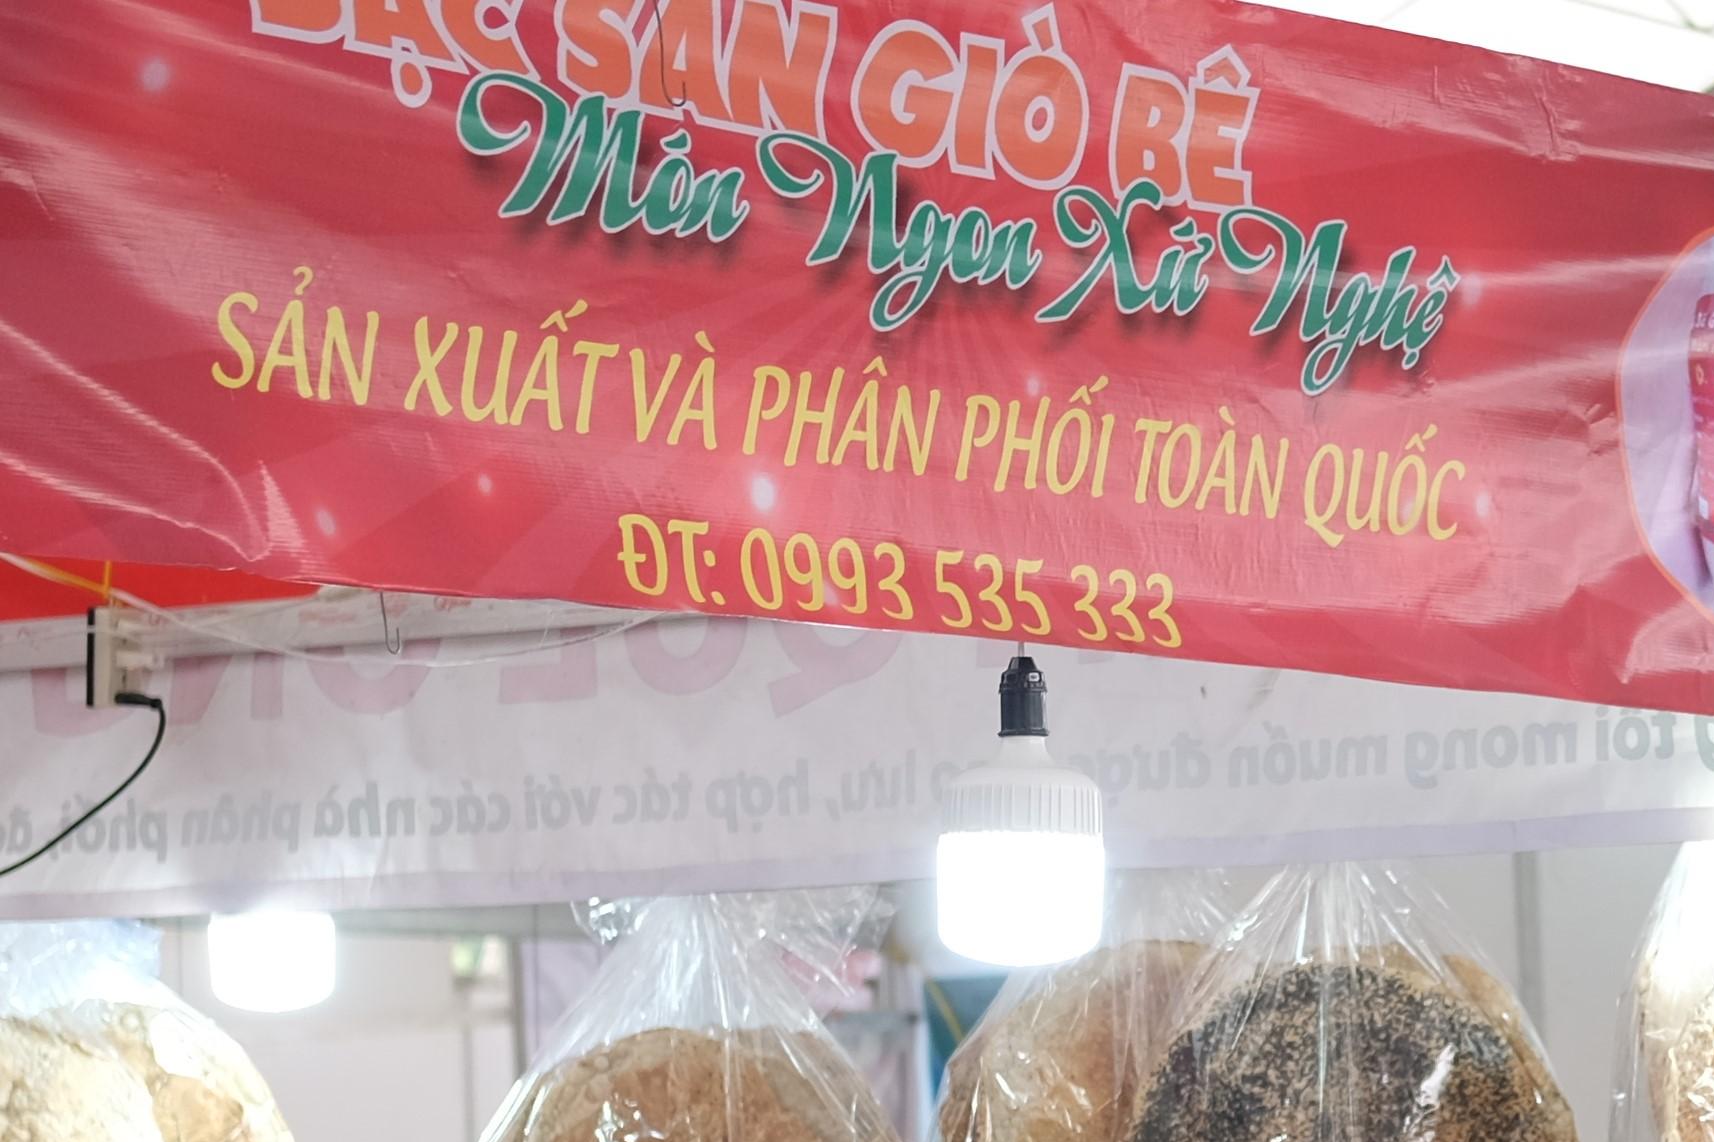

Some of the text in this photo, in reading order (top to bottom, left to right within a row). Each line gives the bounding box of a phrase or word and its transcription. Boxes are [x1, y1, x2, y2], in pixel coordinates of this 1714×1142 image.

[851, 3, 1090, 190] GIÒ
[1108, 43, 1260, 214] BÊ
[457, 72, 1461, 397] Món Ngon Xứ Nghệ
[211, 266, 1465, 547] SẢN XUẤT VÀ PHÂN PHỐI TOÀN QUỐC
[617, 513, 1182, 648] ĐT: 0993 535 333
